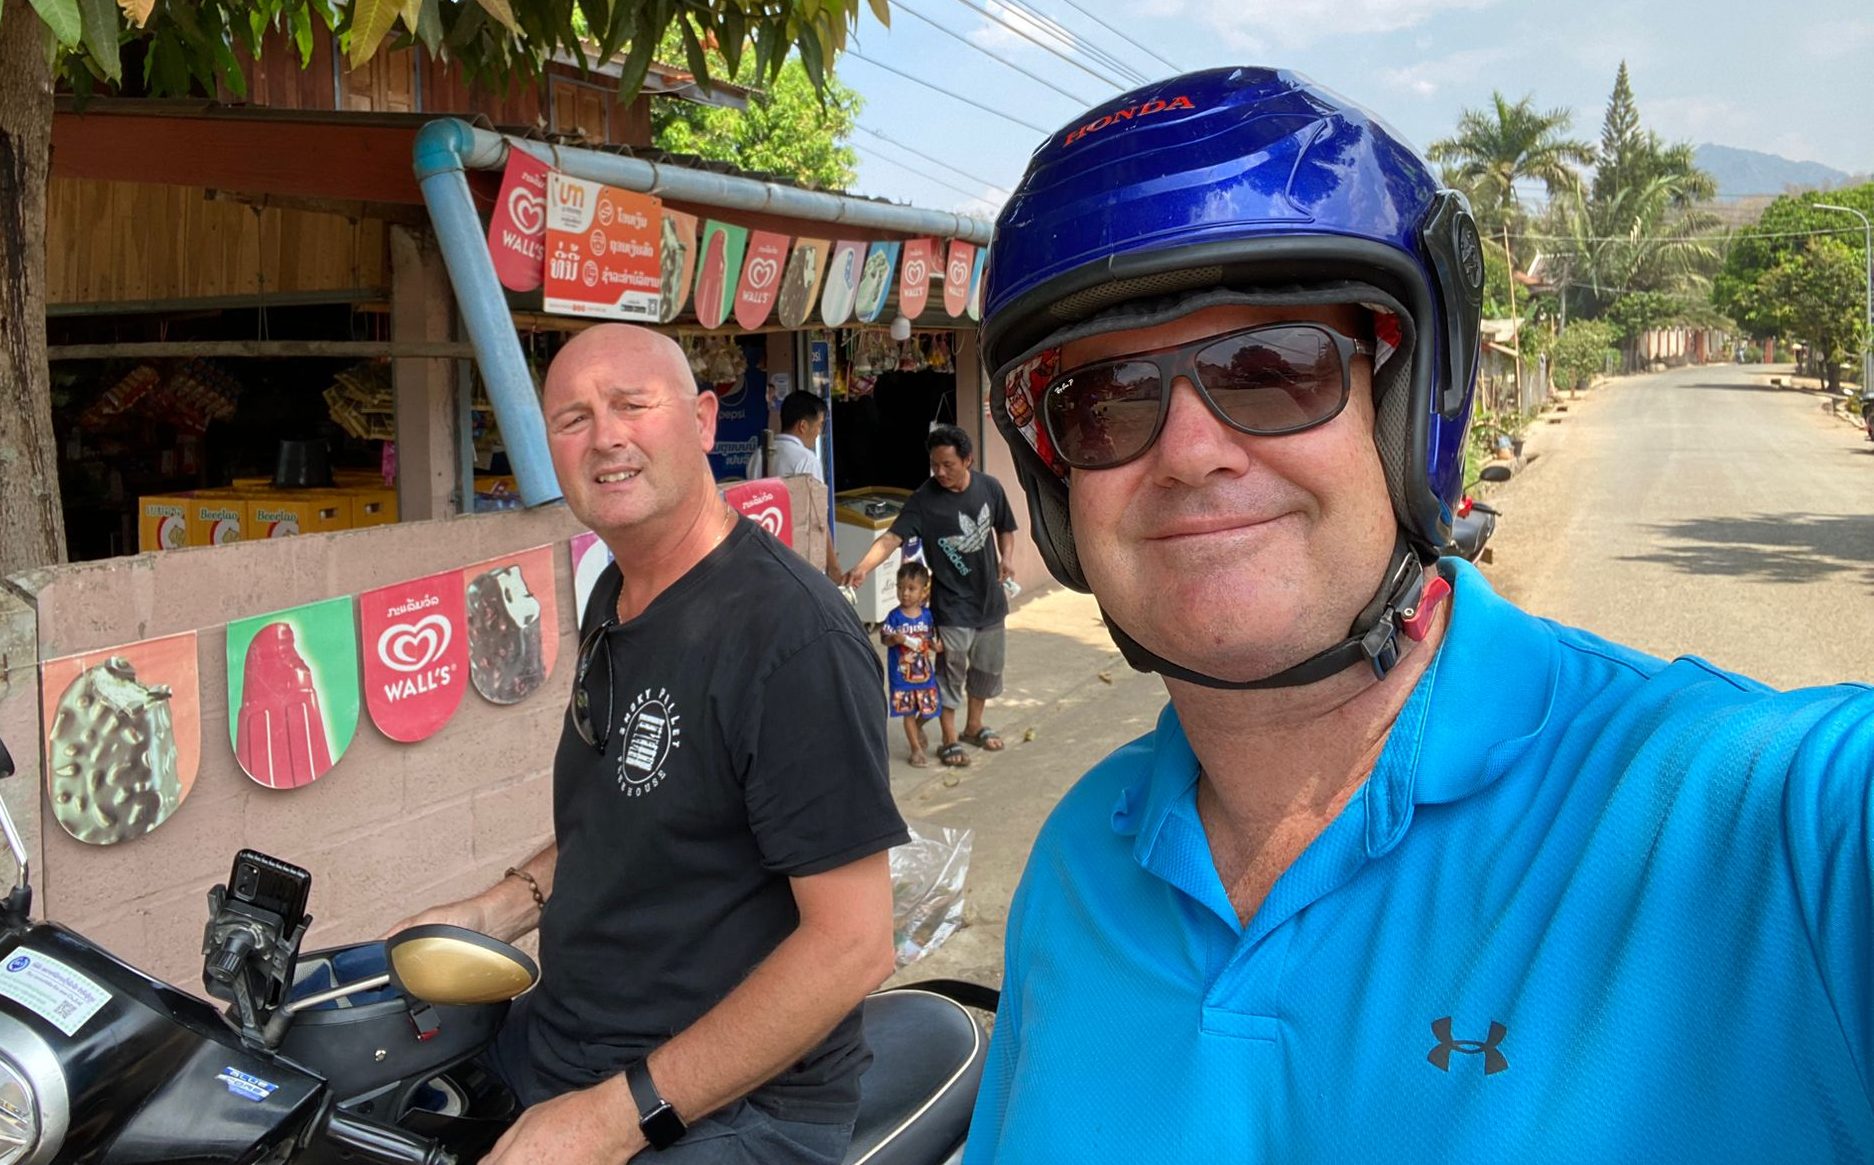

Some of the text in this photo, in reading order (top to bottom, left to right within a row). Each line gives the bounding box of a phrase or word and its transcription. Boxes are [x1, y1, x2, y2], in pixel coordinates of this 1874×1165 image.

[1062, 96, 1195, 147] HONDA
[502, 229, 544, 261] WALL'S
[200, 508, 238, 521] Beerlao
[257, 510, 297, 523] Beerlao
[937, 537, 972, 577] adidas
[384, 664, 452, 703] WALL'S
[229, 1069, 270, 1089] BLUE
